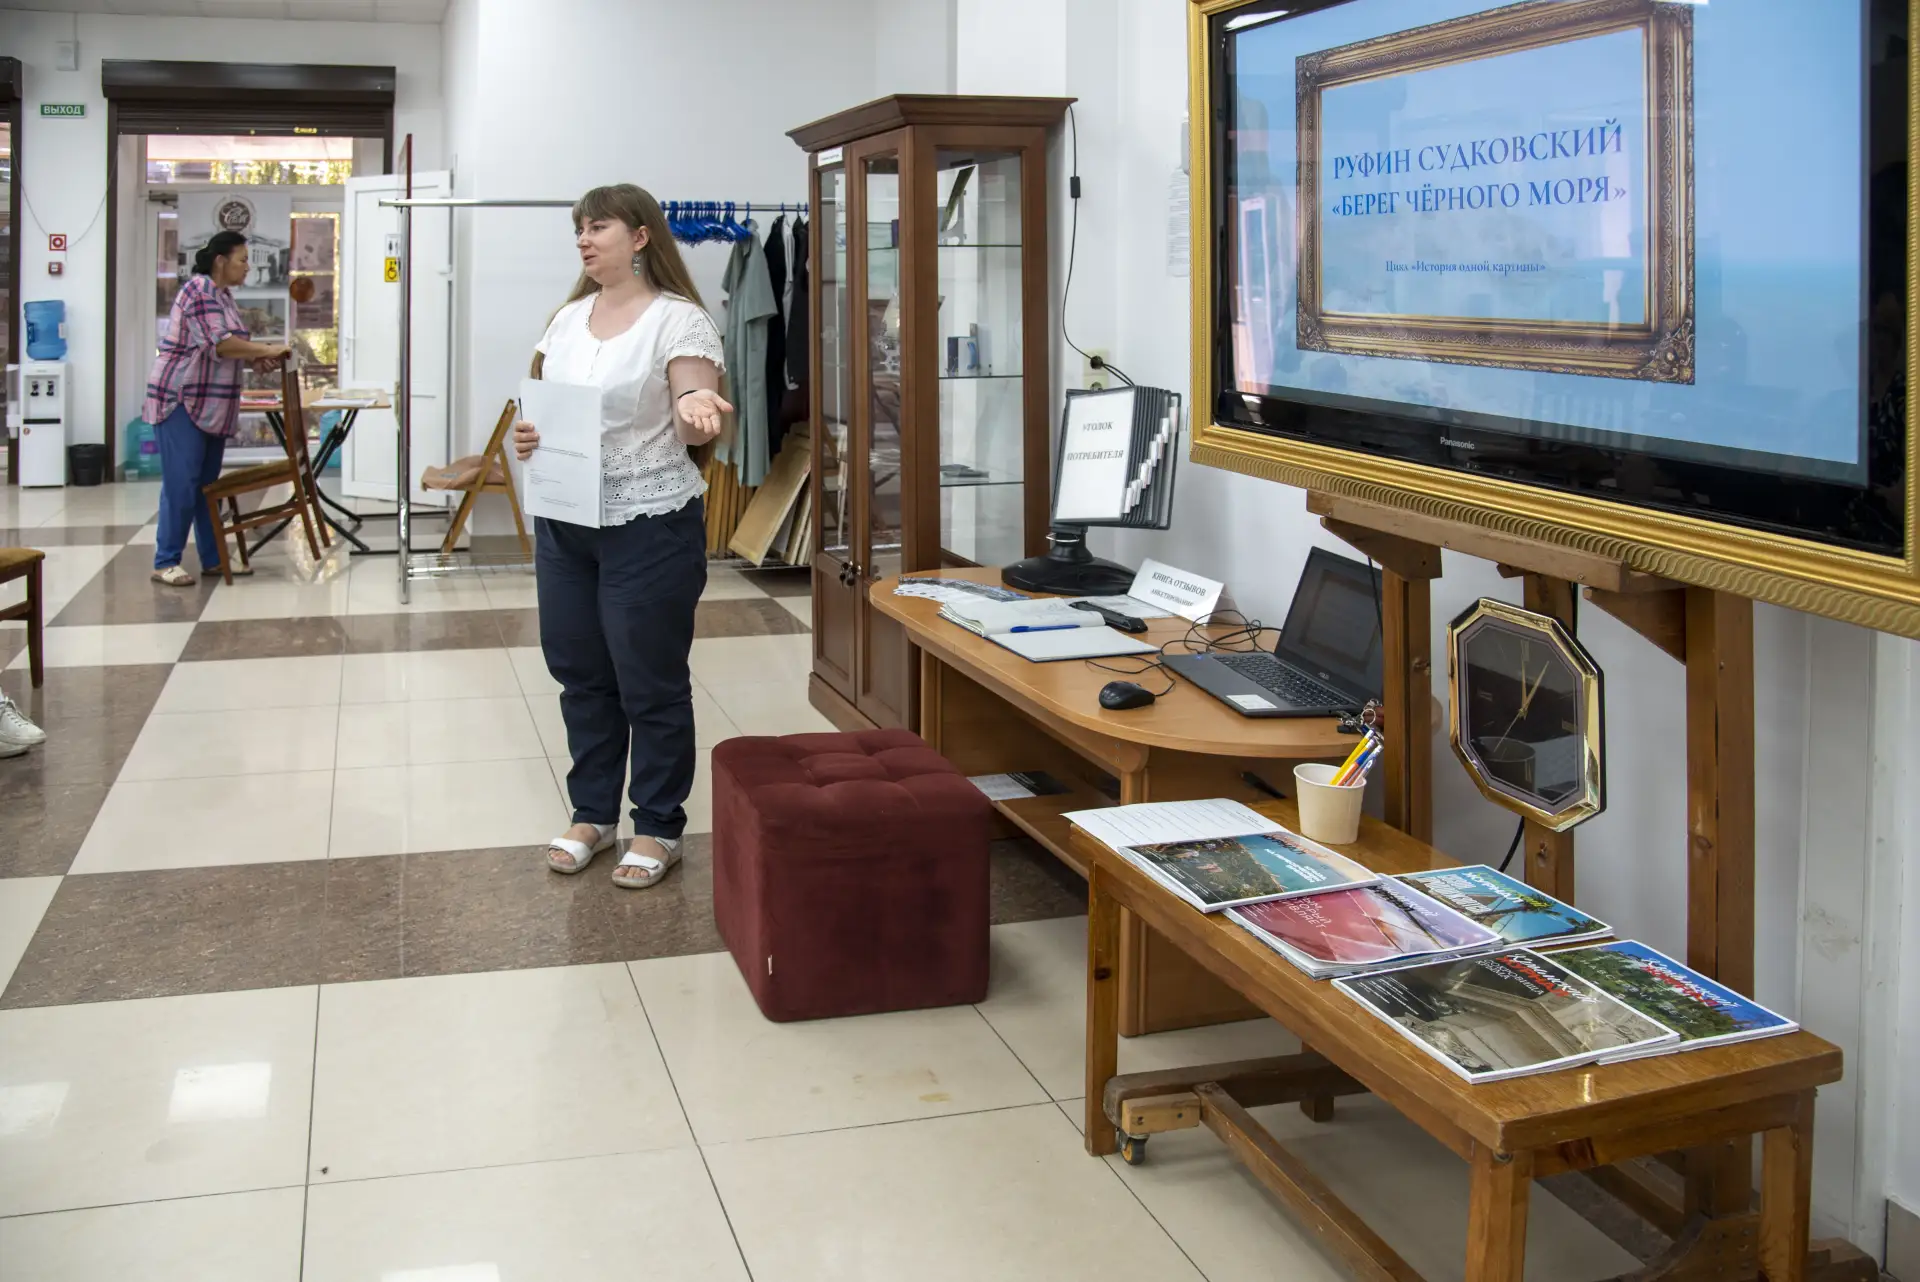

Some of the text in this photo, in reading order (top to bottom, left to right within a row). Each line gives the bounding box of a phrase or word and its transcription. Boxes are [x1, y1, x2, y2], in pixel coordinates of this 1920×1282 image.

[44, 105, 82, 115] ВЫХОД
[1333, 118, 1622, 179] РУФИН СУДКОВСКИЙ
[1332, 176, 1627, 216] «БЕРЕГ ЧЁРНОГО МОРЯ»
[1385, 260, 1546, 276] Цикл «История одной картины»
[1082, 421, 1114, 431] УГОЛОК
[1440, 436, 1475, 450] Panasonic
[1067, 450, 1124, 461] ПОТРЕБИТЕЛЯ
[1152, 572, 1206, 597] КНИГА ОТЗЫВОВ
